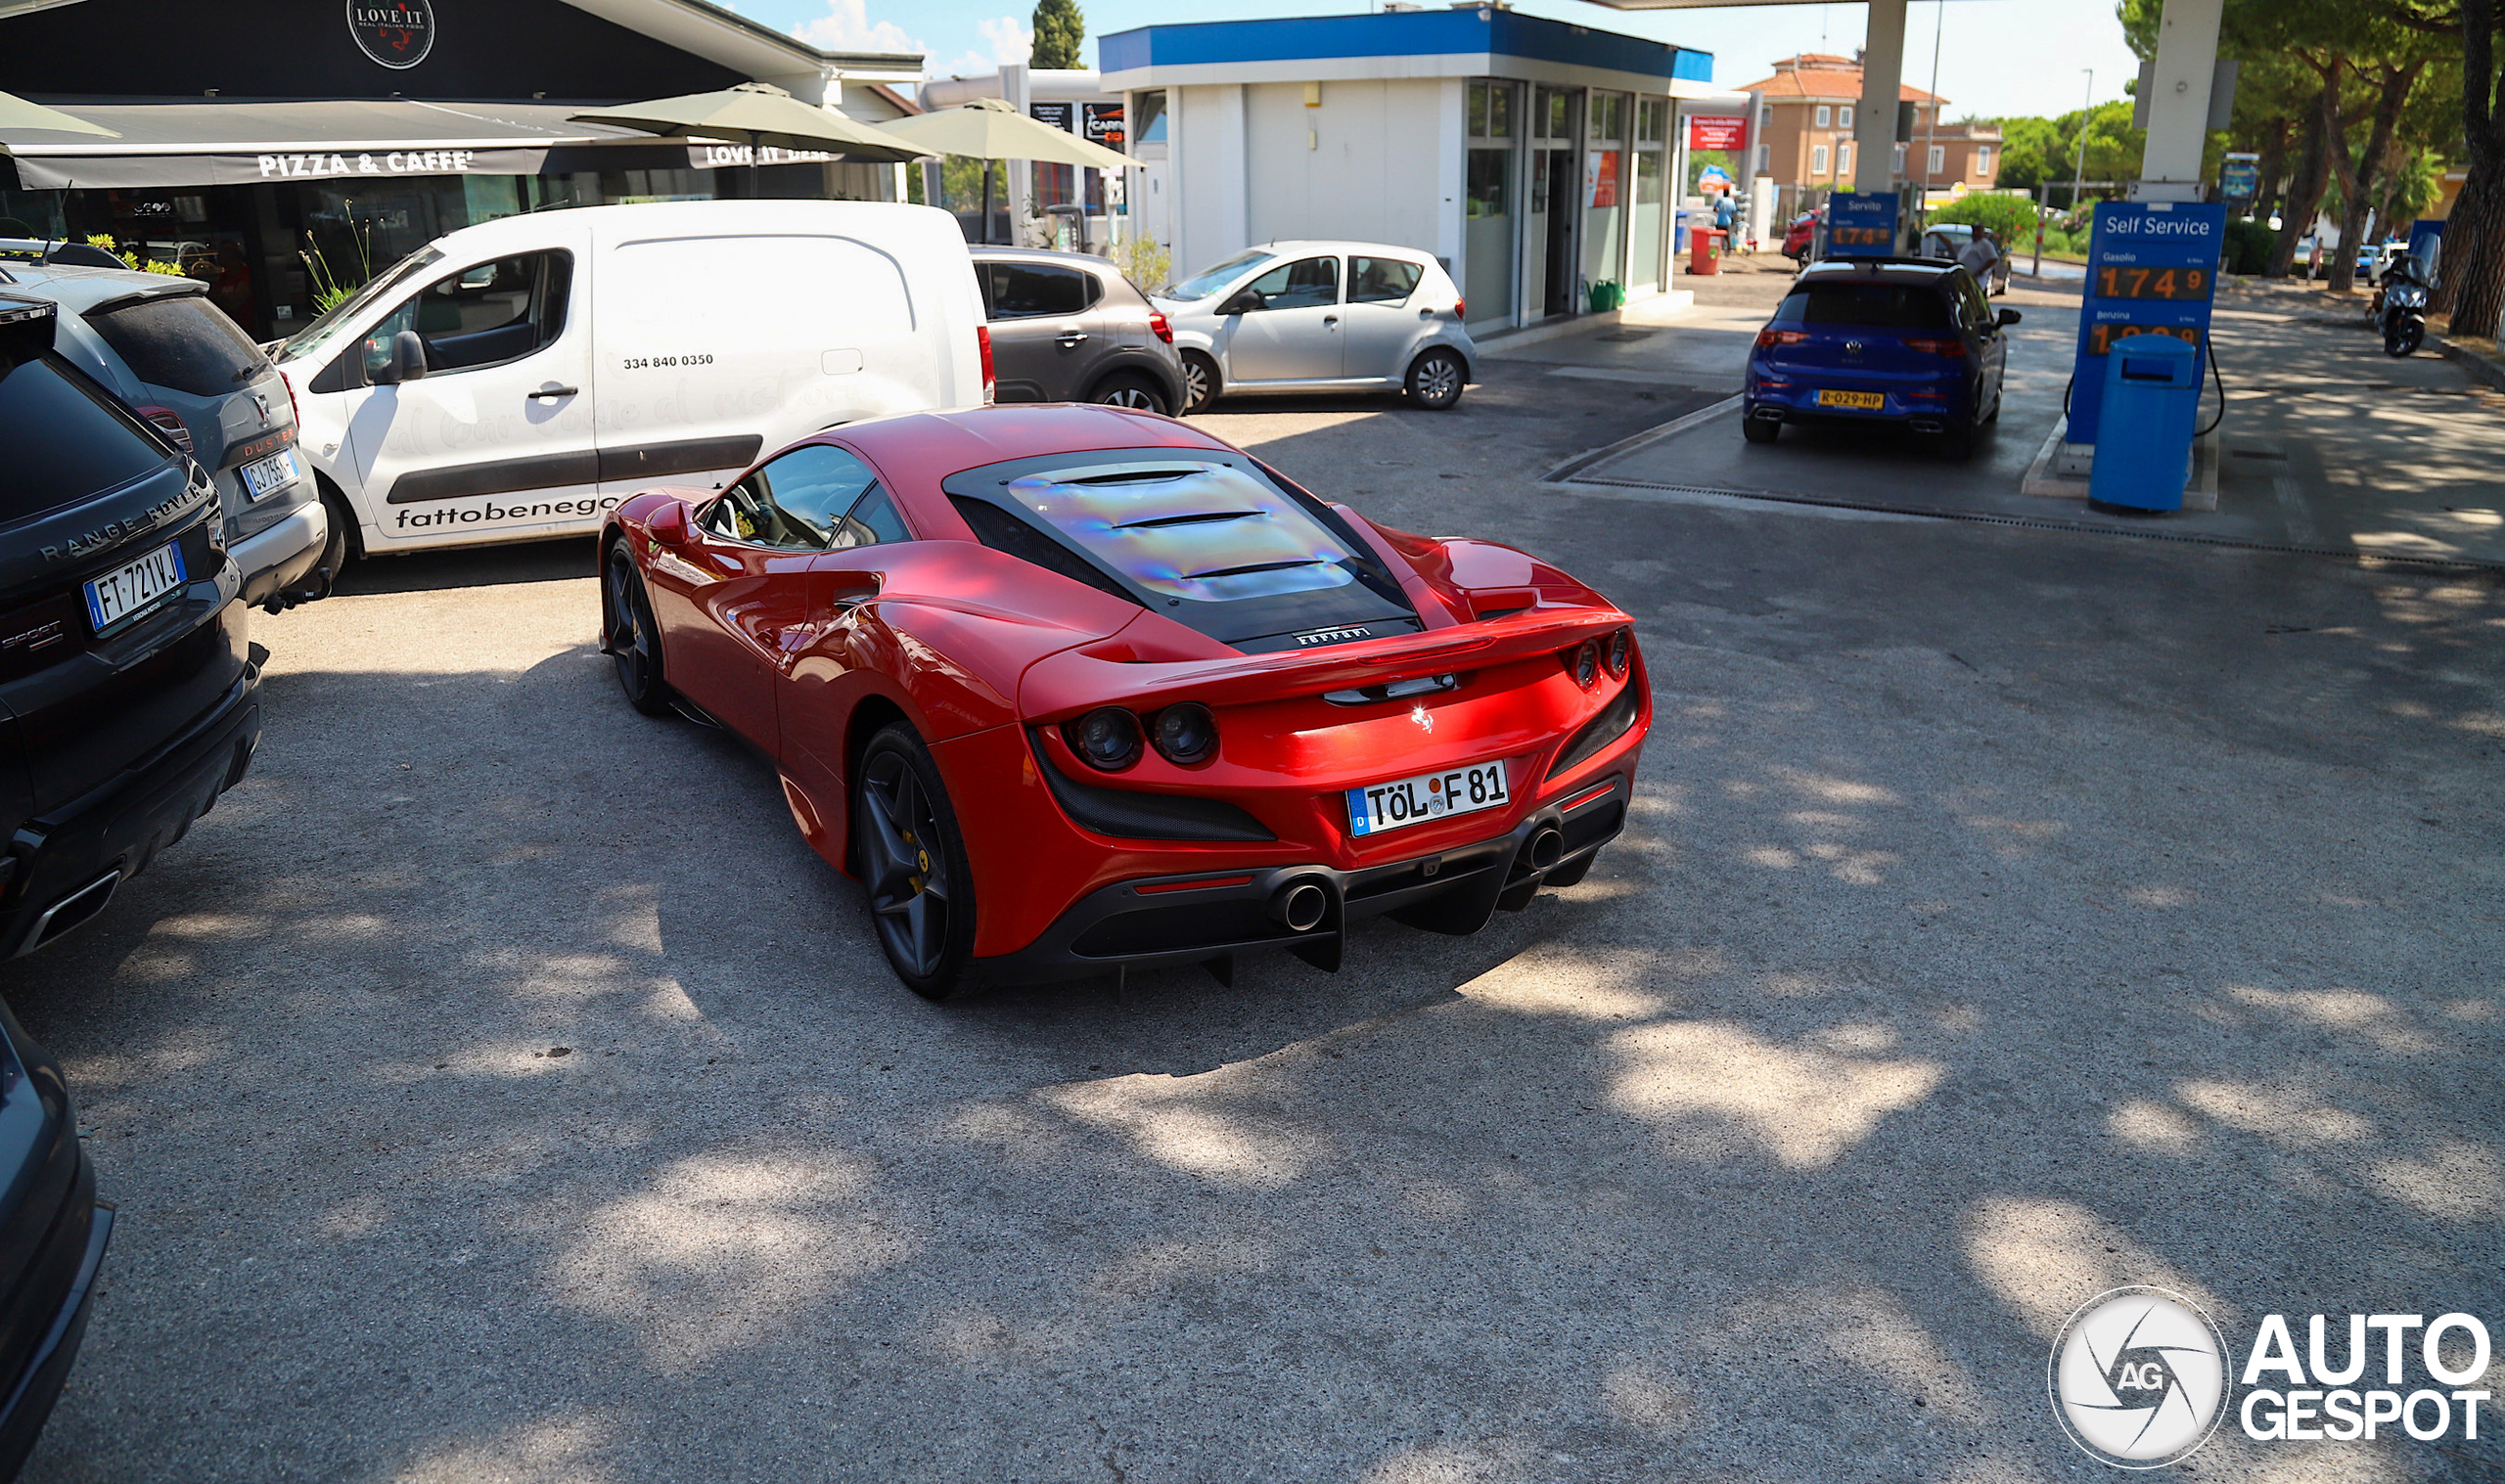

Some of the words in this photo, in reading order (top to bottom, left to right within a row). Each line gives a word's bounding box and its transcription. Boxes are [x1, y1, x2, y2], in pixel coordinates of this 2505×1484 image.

[357, 8, 401, 23] LOVE
[406, 11, 423, 24] IT
[761, 146, 779, 163] IT
[257, 154, 351, 177] PIZZA
[358, 153, 382, 174] &
[1847, 200, 1882, 211] Servito
[2106, 216, 2141, 235] Self
[2145, 217, 2209, 236] Service
[2103, 251, 2136, 263] Gasolio
[2096, 310, 2130, 321] Benzina
[623, 358, 648, 370] 334
[653, 356, 677, 368] 840
[681, 354, 713, 366] 0350
[244, 428, 295, 457] DUSTER
[39, 517, 136, 562] RANGE
[145, 485, 203, 521] ROVER
[2, 620, 62, 649] SPORT
[1367, 782, 1429, 826] TÖL
[1356, 816, 1365, 827] D
